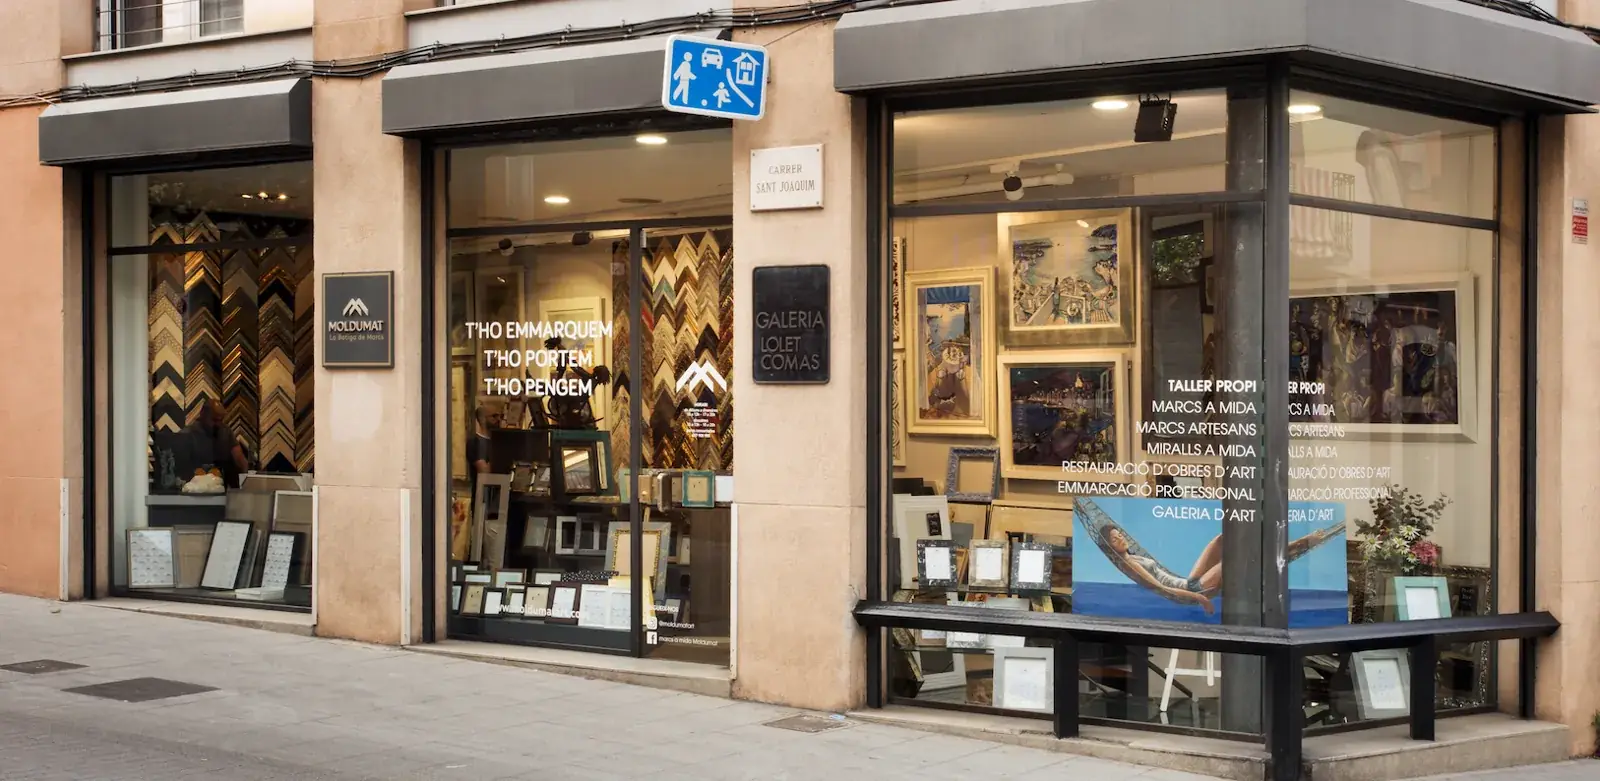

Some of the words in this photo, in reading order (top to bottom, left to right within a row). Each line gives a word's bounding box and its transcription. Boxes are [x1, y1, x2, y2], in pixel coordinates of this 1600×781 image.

[768, 164, 802, 174] CARRER
[756, 181, 776, 194] SANT
[780, 179, 815, 193] JOAQUIM
[328, 320, 384, 332] MOLDUMAT
[756, 310, 826, 329] GALERIA
[465, 321, 502, 339] T'HO
[506, 320, 613, 341] EMMARQUEM
[760, 336, 801, 353] LOLET
[484, 349, 521, 368] T'HO
[525, 349, 593, 368] PORTEM
[760, 353, 821, 371] COMAS
[484, 378, 521, 396] T'HO
[525, 378, 593, 397] PENGEM
[1168, 379, 1213, 393] TALLER
[1216, 379, 1257, 393] PROPI
[1300, 381, 1326, 395] PROPI
[1152, 400, 1202, 414] MARCS
[1204, 401, 1216, 414] A
[1219, 401, 1257, 415] MIDA
[1303, 403, 1311, 416] A
[1312, 403, 1336, 416] MIDA
[1136, 421, 1185, 435] MARCS
[1188, 422, 1257, 437] ARTESANS
[1303, 424, 1345, 438] ARTESANS
[1147, 442, 1202, 457] MIRALLS
[1204, 443, 1216, 457] A
[1219, 443, 1257, 458] MIDA
[1306, 446, 1314, 458] A
[1315, 446, 1338, 458] MIDA
[1062, 460, 1149, 476] RESTAURACIÓ
[1152, 463, 1211, 478] D'OBRES
[1214, 465, 1256, 479] D'ART
[1057, 480, 1152, 498] EMMARCACIÓ
[1155, 484, 1256, 501] PROFESSIONAL
[1152, 505, 1211, 521] GALERIA
[1214, 508, 1256, 523] D'ART
[1308, 507, 1334, 522] D'ART
